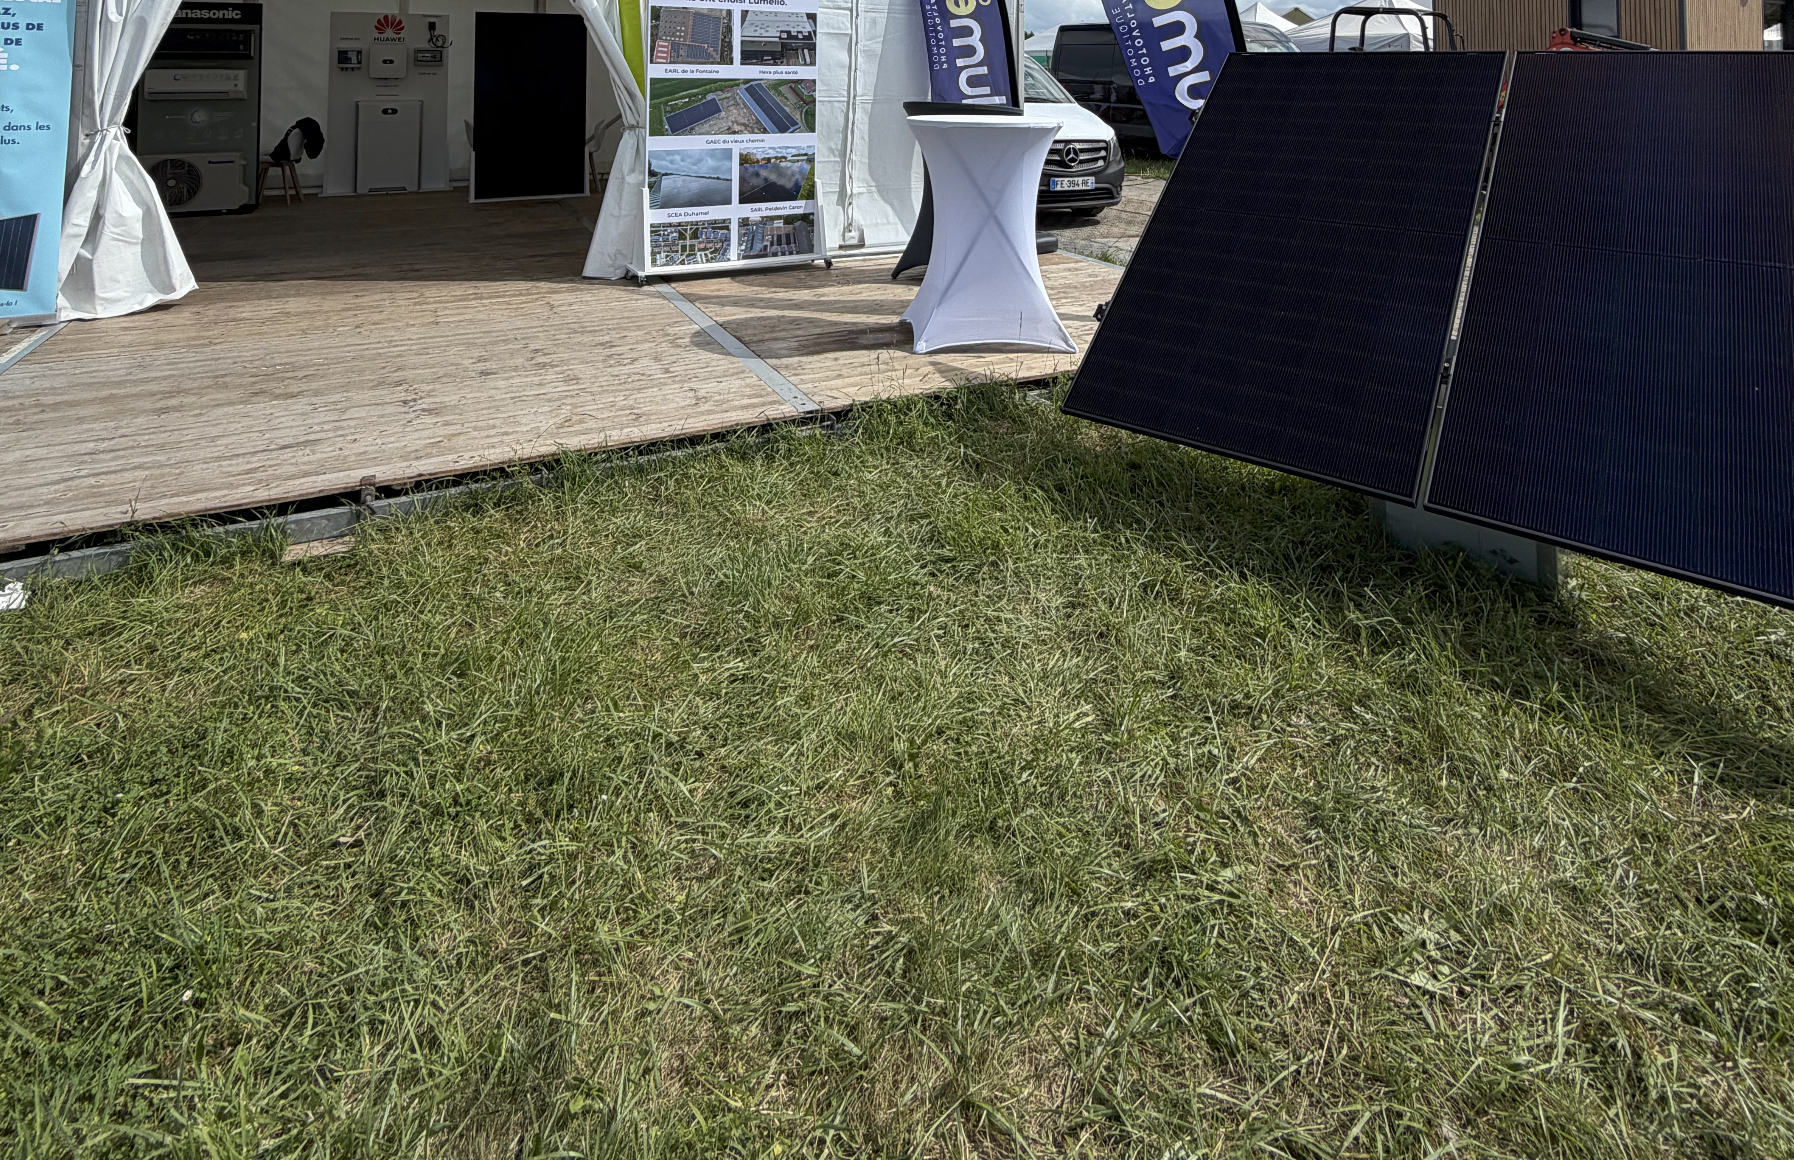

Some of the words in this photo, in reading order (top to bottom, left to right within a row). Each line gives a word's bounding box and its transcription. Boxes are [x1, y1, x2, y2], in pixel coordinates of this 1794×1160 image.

[0, 7, 17, 18] Z,
[174, 7, 242, 19] anasonic
[25, 22, 44, 31] DE
[3, 37, 23, 46] DE
[3, 121, 32, 131] dans
[35, 121, 51, 131] les
